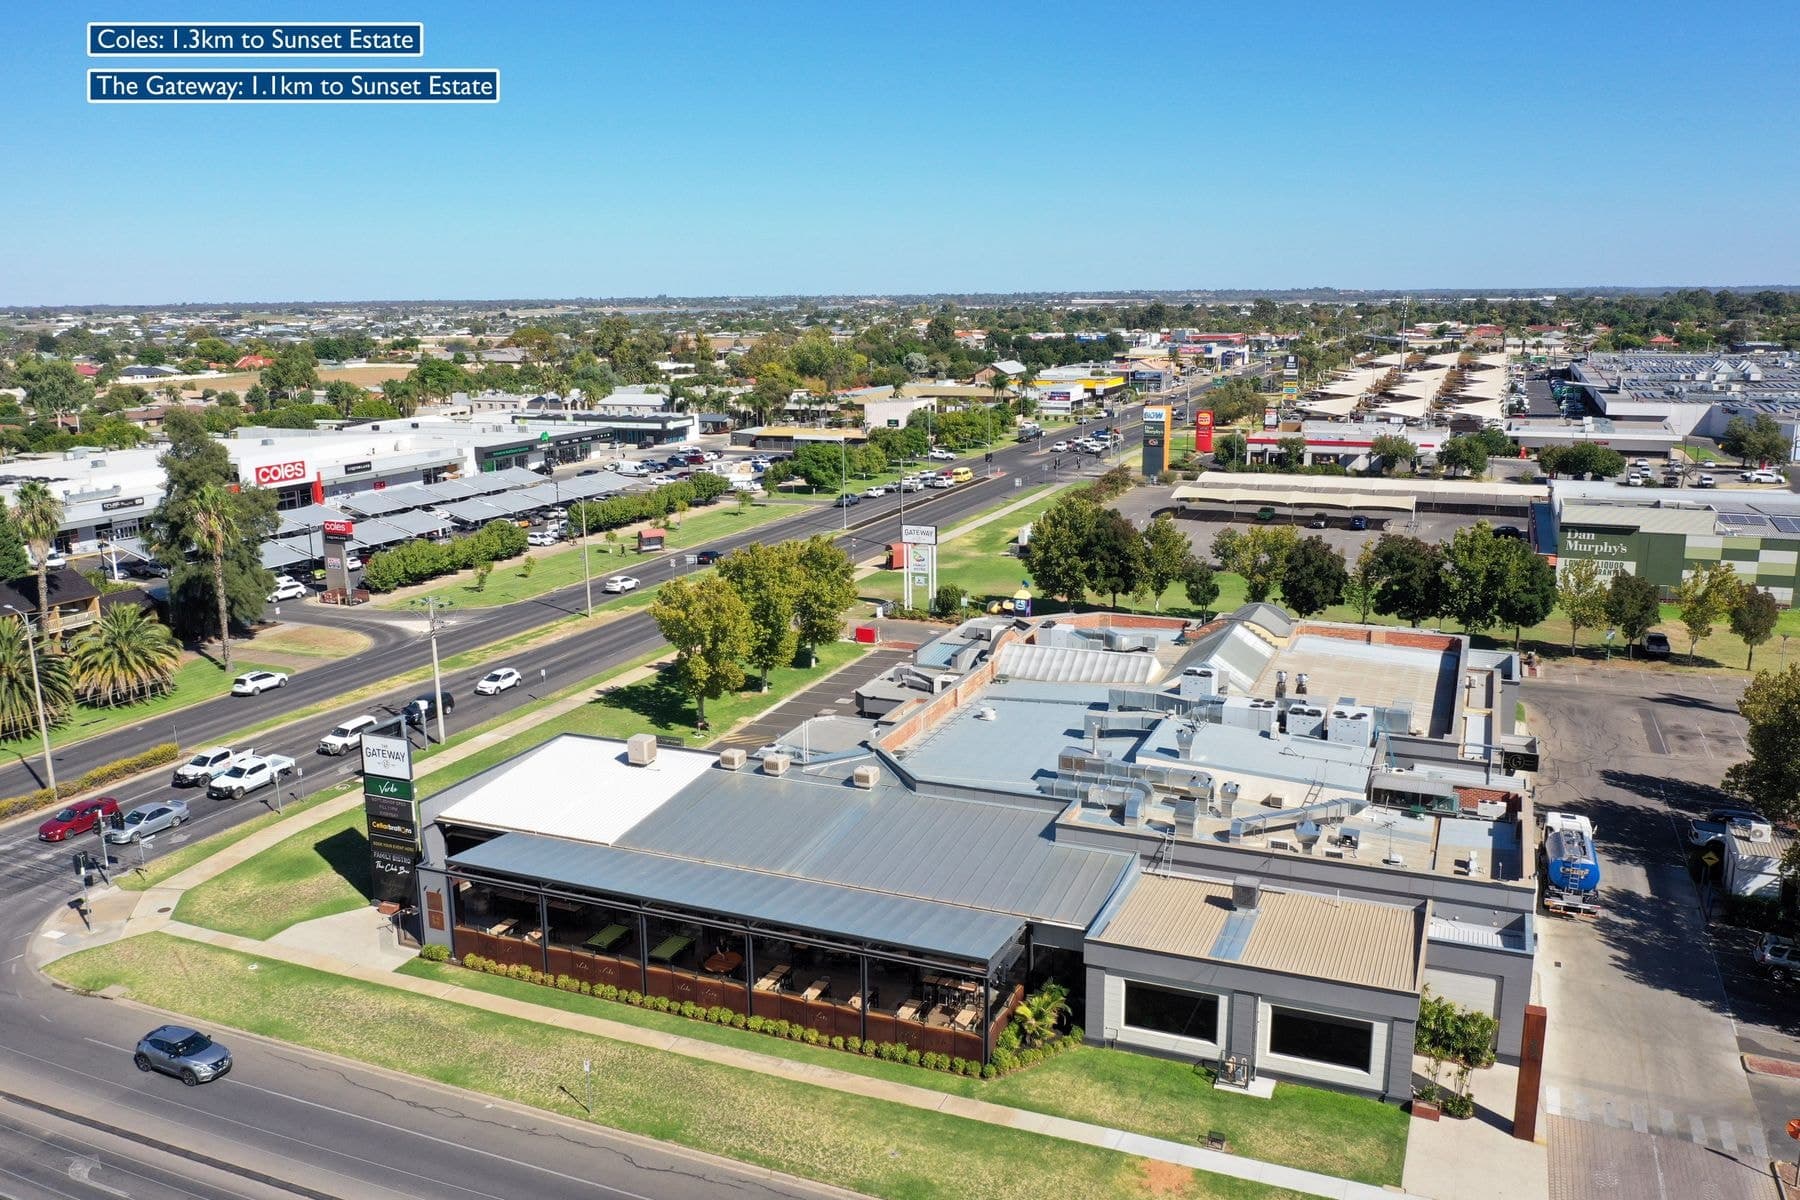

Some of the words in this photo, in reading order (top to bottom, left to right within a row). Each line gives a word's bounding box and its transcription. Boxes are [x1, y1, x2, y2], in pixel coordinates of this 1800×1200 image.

[258, 462, 304, 482] coles
[324, 521, 346, 532] coles
[904, 528, 934, 537] GATEWAY
[1566, 528, 1595, 540] Dan
[1565, 540, 1628, 556] Murphy's
[1596, 561, 1625, 570] LIQUOR
[365, 746, 406, 762] GATEWAY
